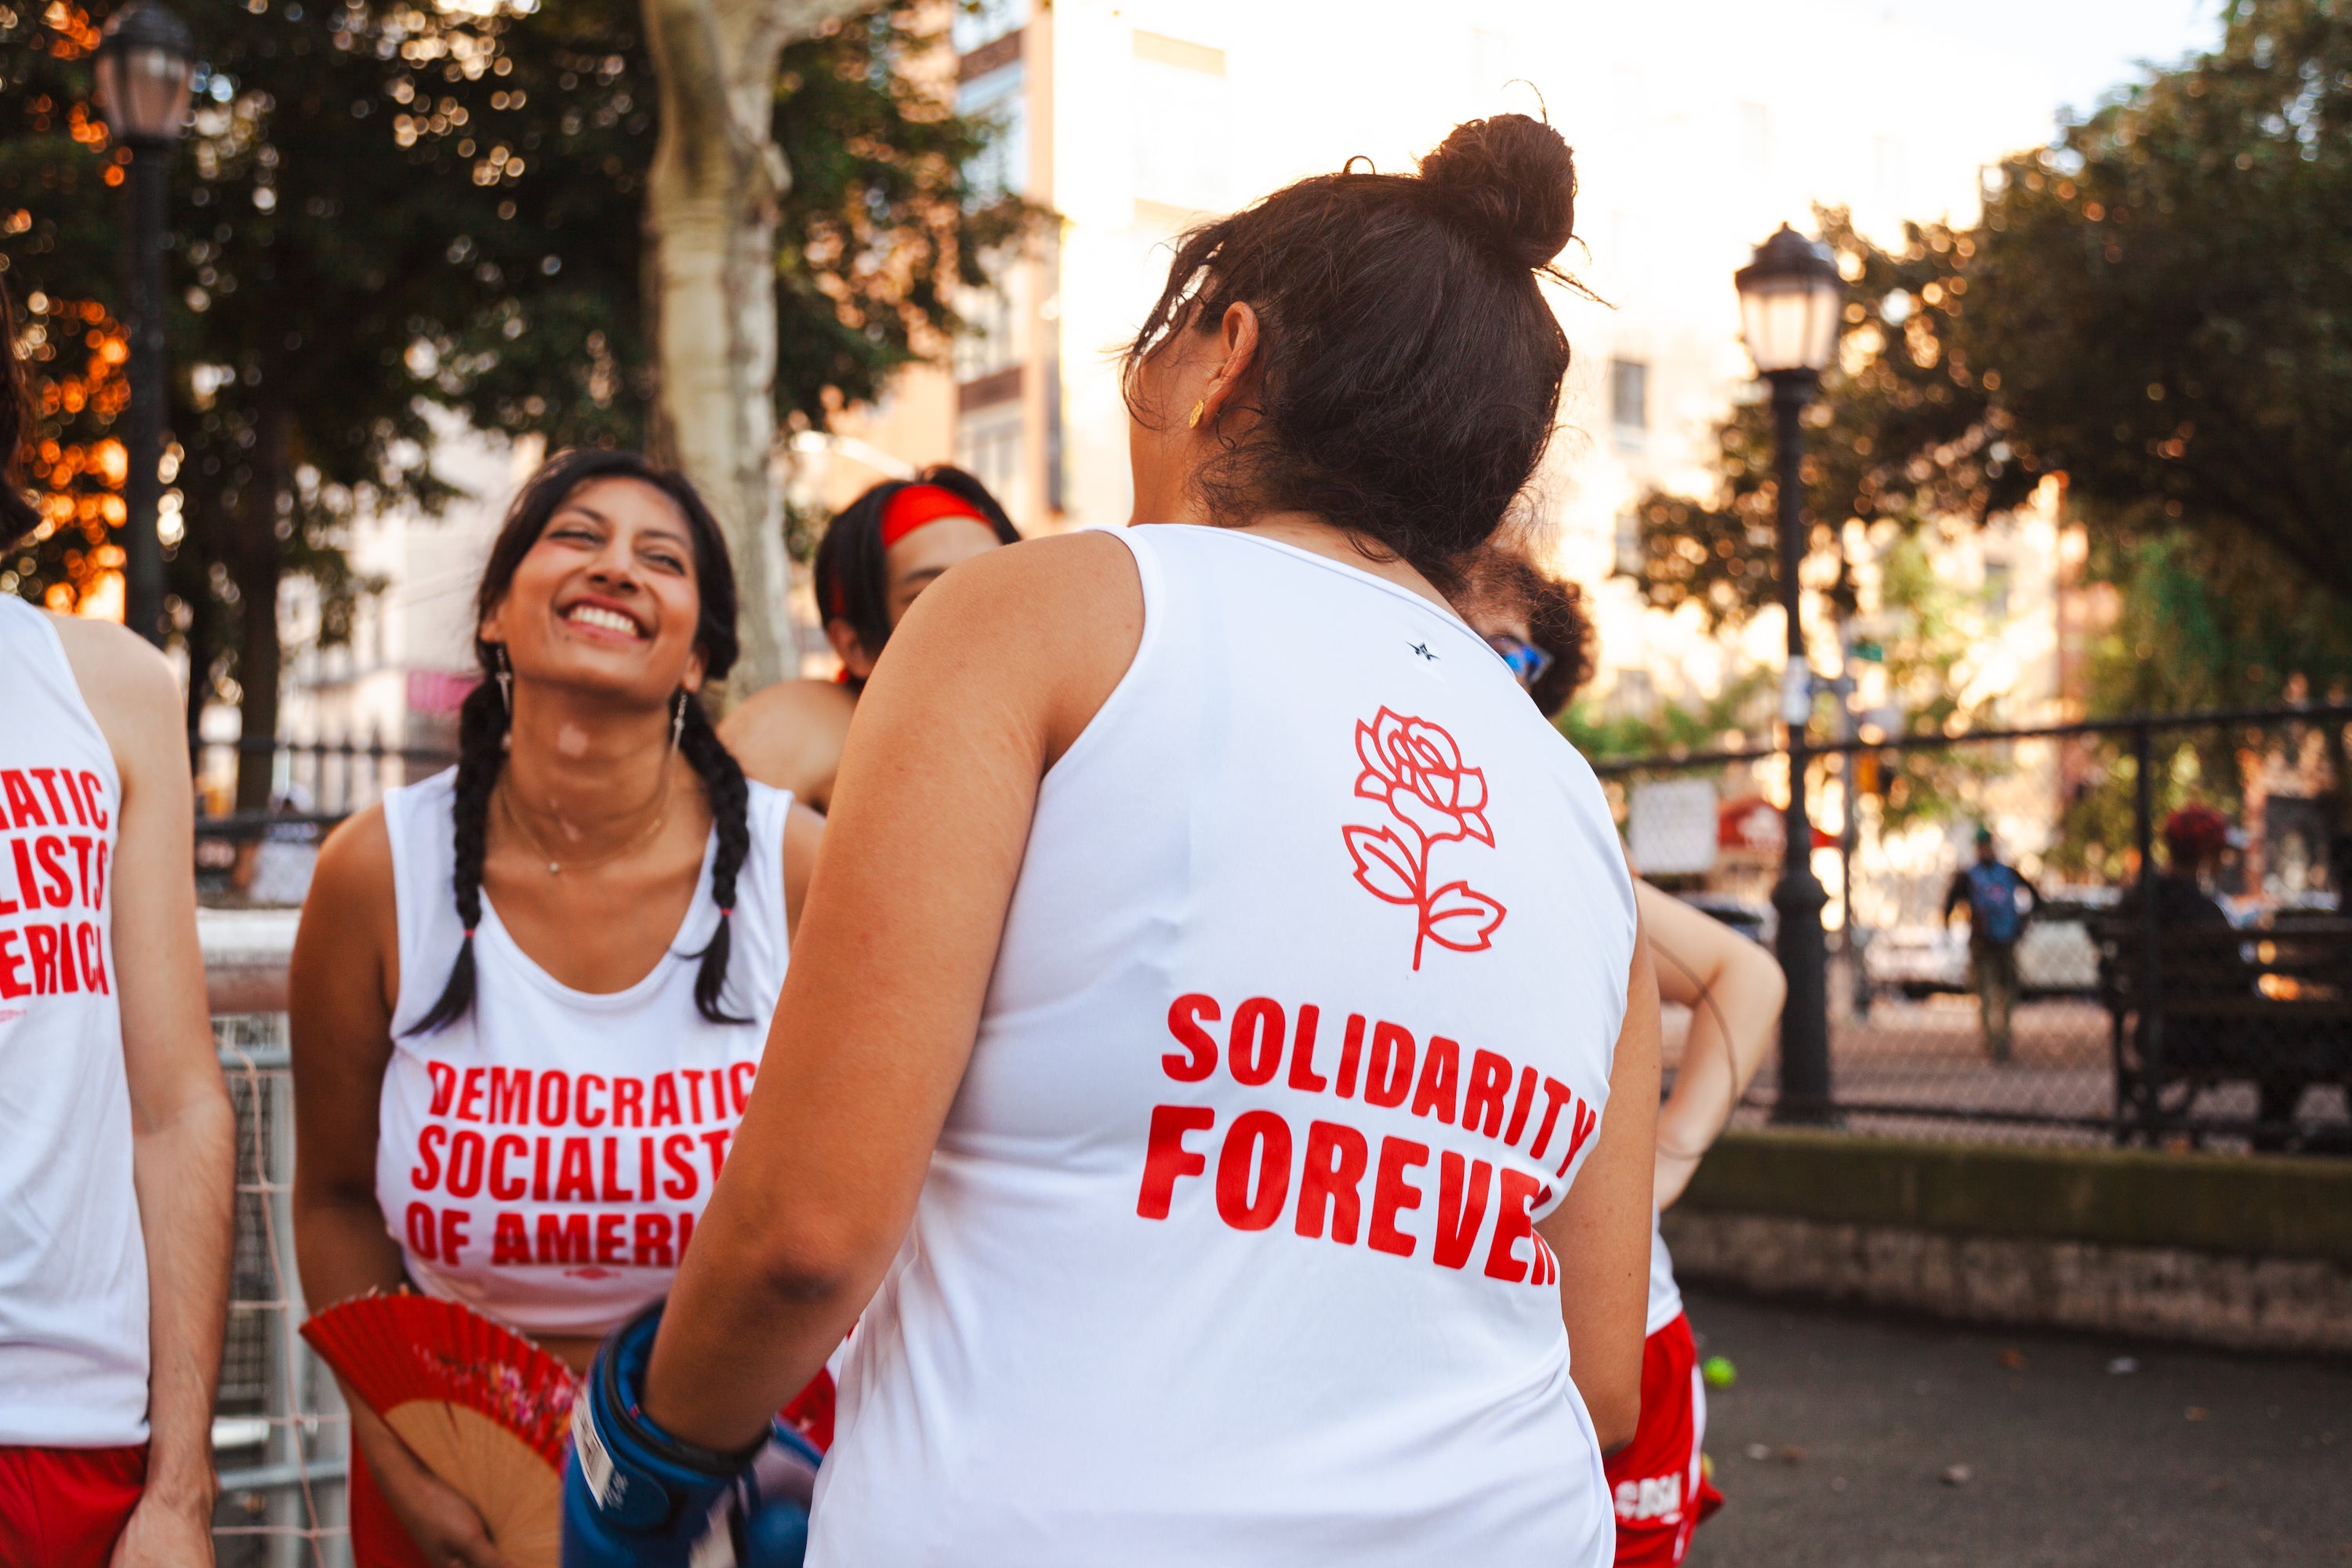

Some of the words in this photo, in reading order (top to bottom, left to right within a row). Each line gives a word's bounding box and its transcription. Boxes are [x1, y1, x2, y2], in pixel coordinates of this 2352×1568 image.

[426, 1061, 757, 1129] DEMOCRATIC
[1161, 993, 1596, 1179] SOLIDARITY
[411, 1124, 741, 1203] SOCIALIST
[406, 1200, 470, 1266] OF
